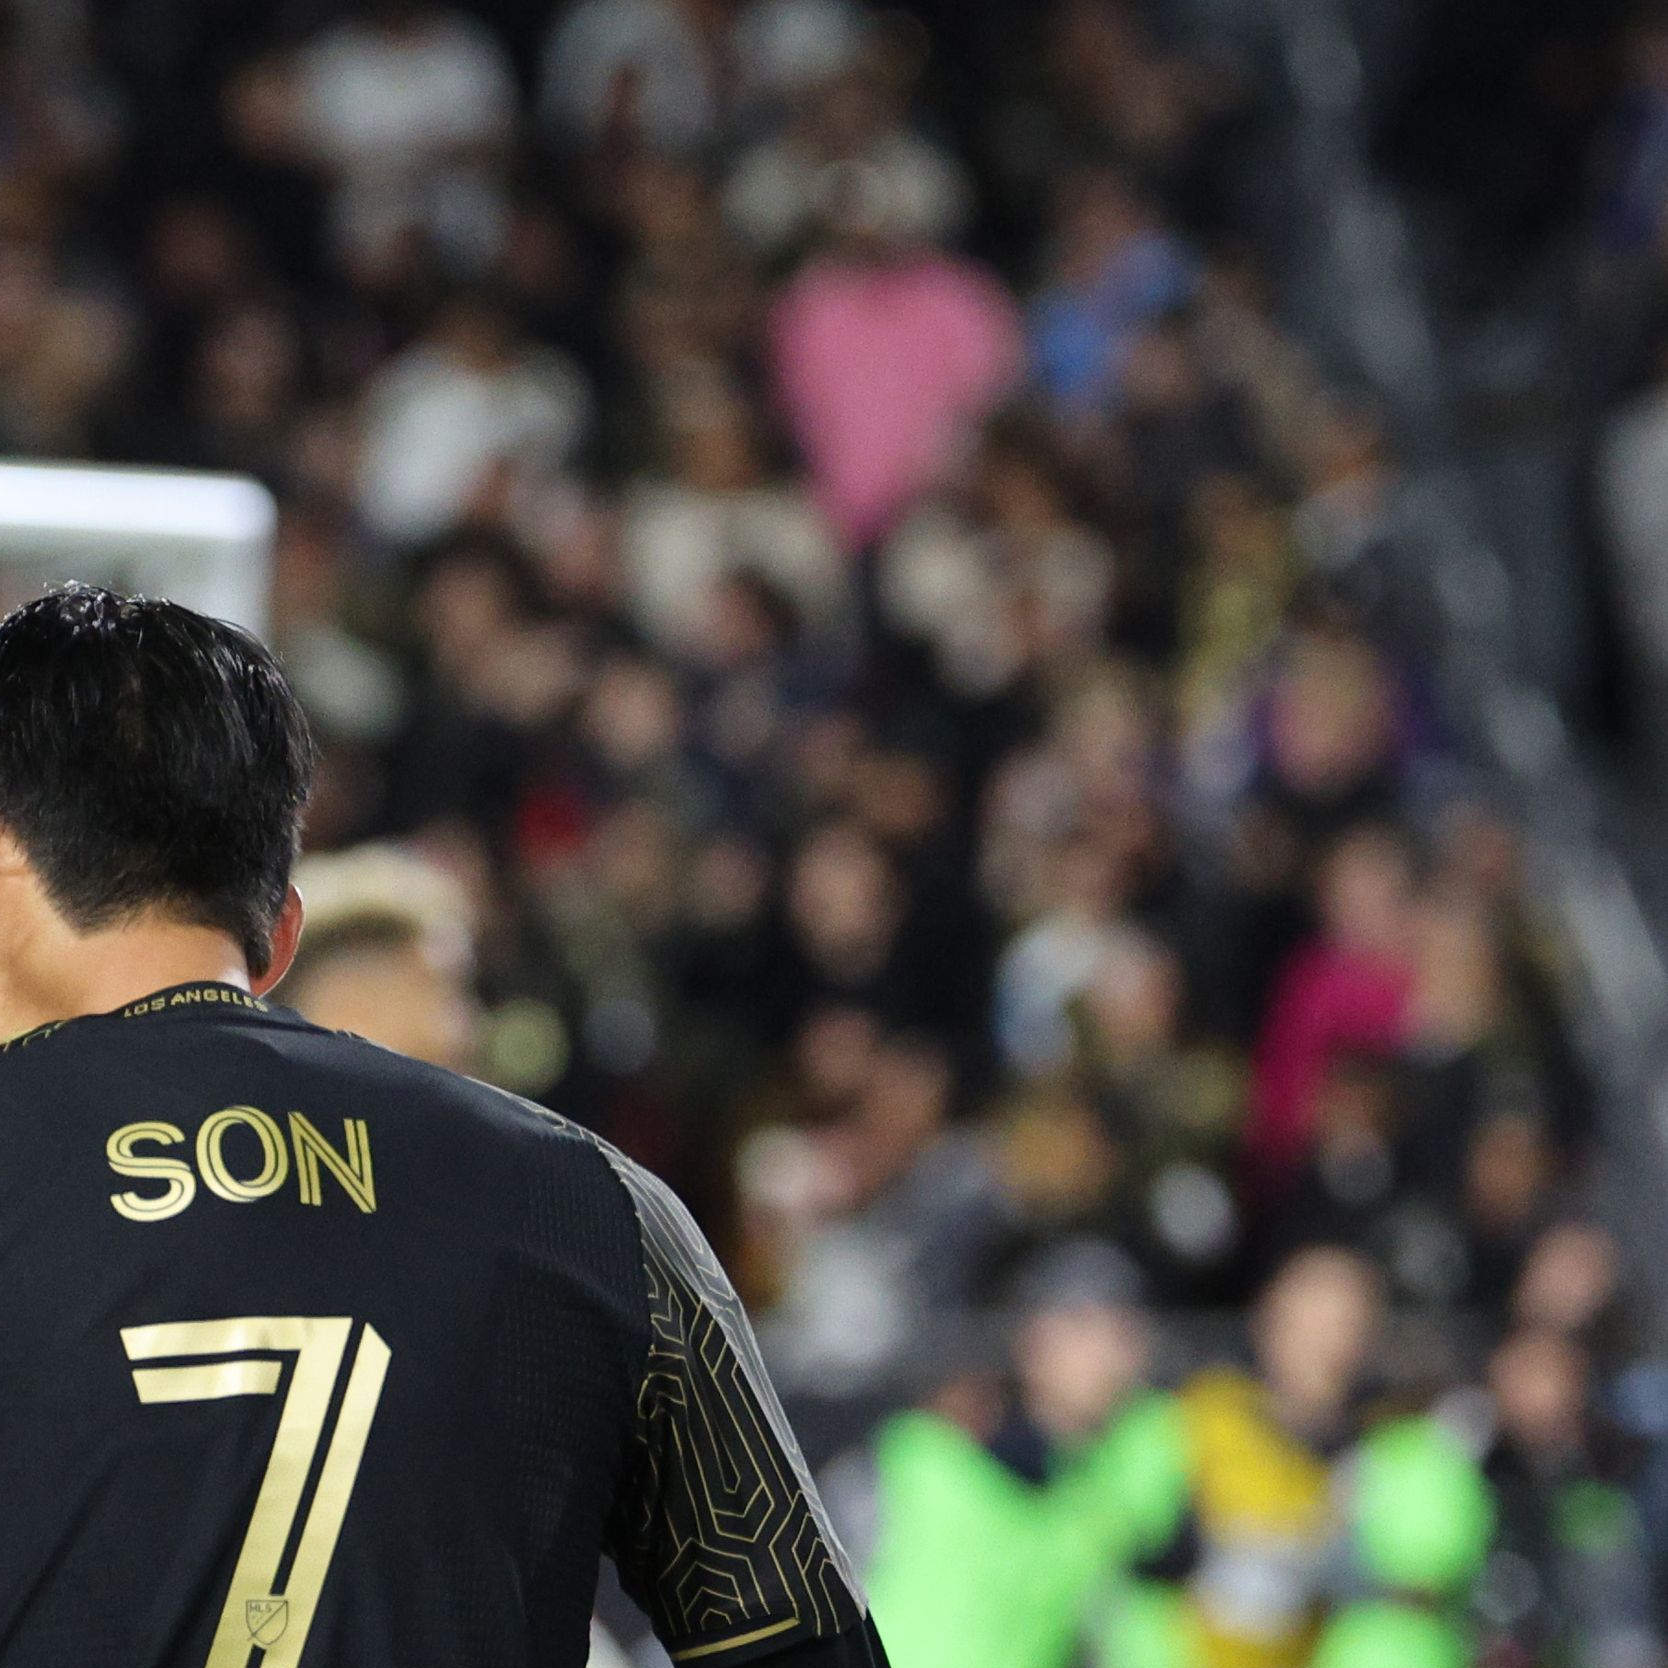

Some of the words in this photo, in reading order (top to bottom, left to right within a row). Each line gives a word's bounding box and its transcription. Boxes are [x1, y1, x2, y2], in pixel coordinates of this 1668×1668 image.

[124, 997, 165, 1018] LOS
[170, 987, 268, 1013] ANGELES
[106, 1105, 376, 1222] SON
